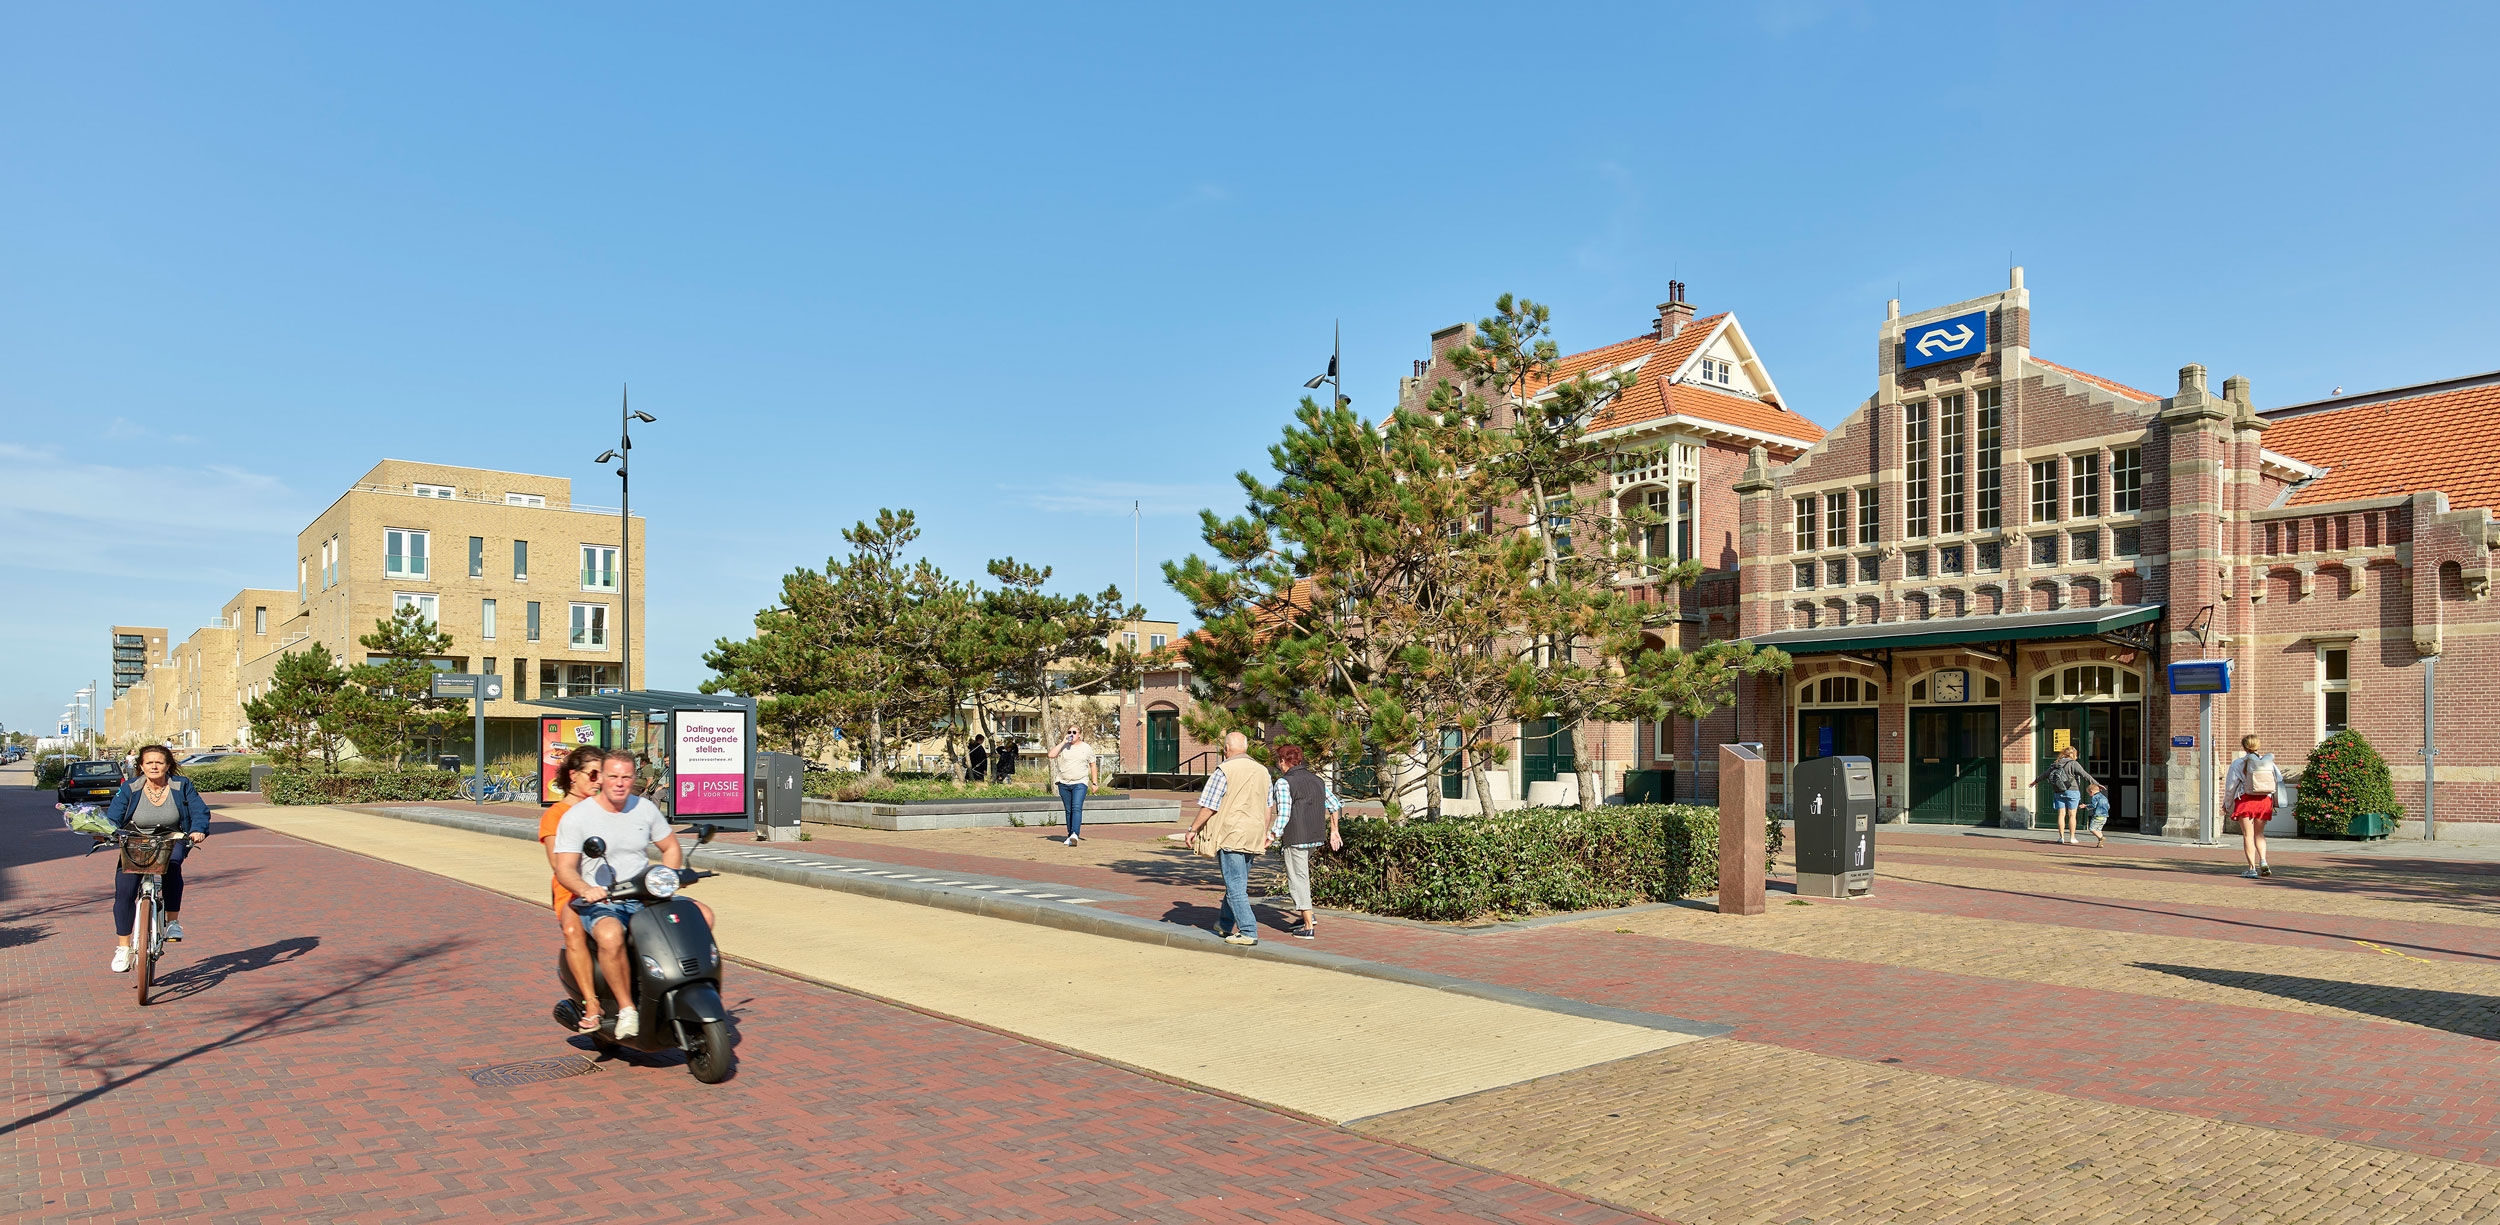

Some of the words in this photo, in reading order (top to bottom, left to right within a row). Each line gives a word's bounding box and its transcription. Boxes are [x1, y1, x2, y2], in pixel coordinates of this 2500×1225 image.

[686, 725, 714, 734] Dating
[683, 735, 738, 744] ondeugende
[703, 781, 738, 790] PASSIE
